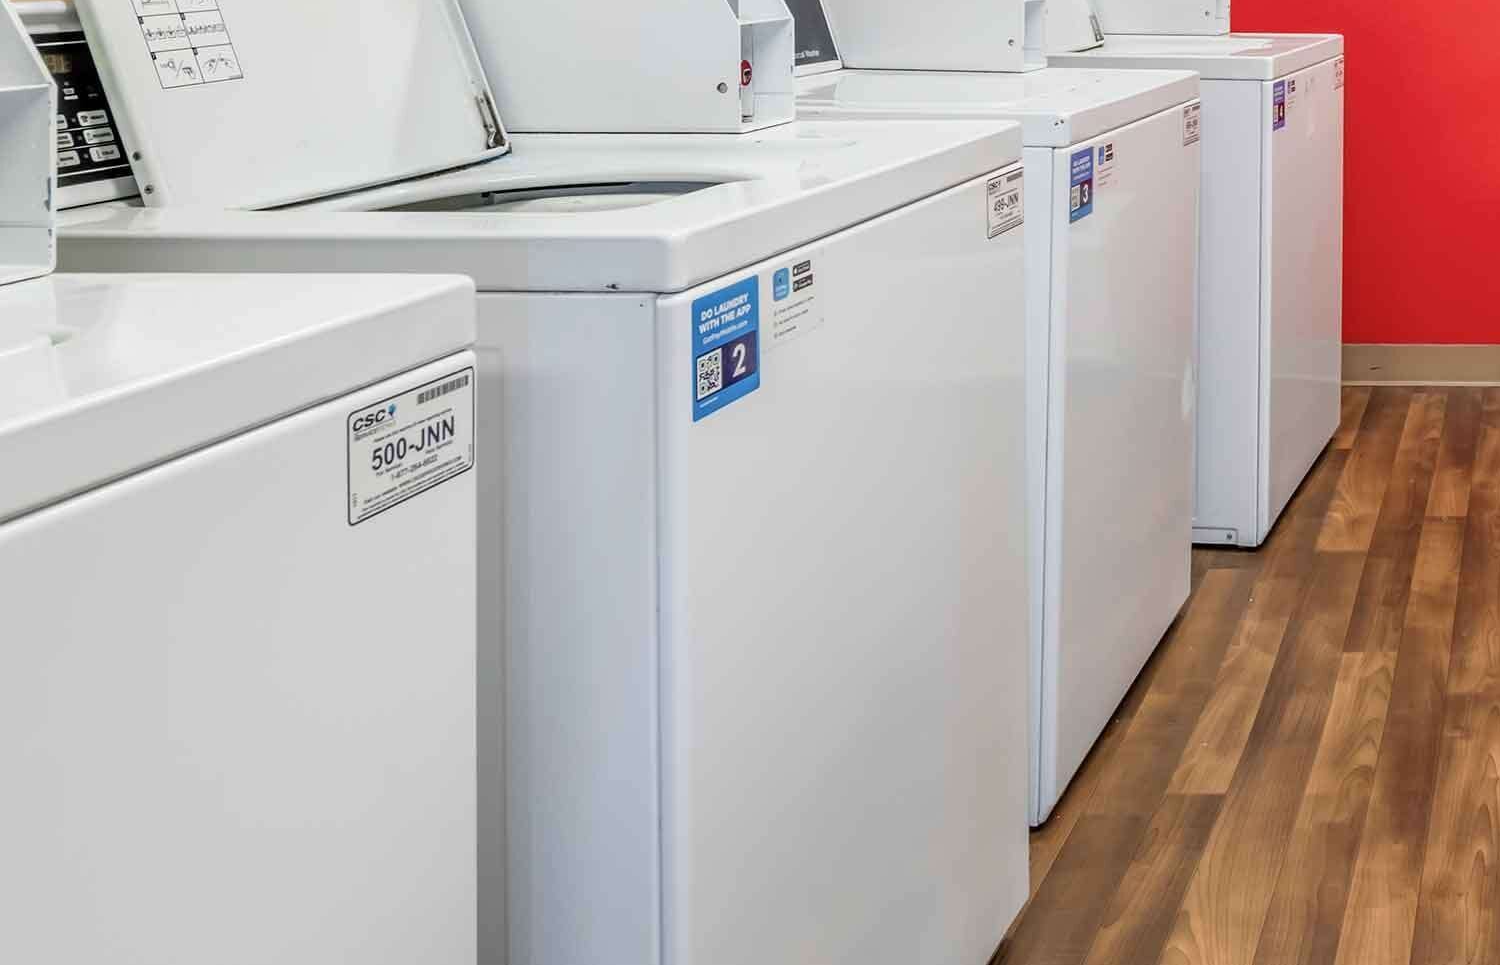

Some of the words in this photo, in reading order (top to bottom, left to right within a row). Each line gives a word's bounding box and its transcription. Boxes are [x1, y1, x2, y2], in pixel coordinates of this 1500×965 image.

[1082, 184, 1089, 203] 3
[699, 317, 719, 334] WITH
[720, 309, 736, 325] THE
[736, 304, 752, 317] APP
[701, 308, 713, 321] DO
[714, 292, 749, 316] LAUNDRY
[732, 343, 747, 378] 2
[353, 409, 386, 431] CSC
[371, 415, 455, 471] 500-JNN
